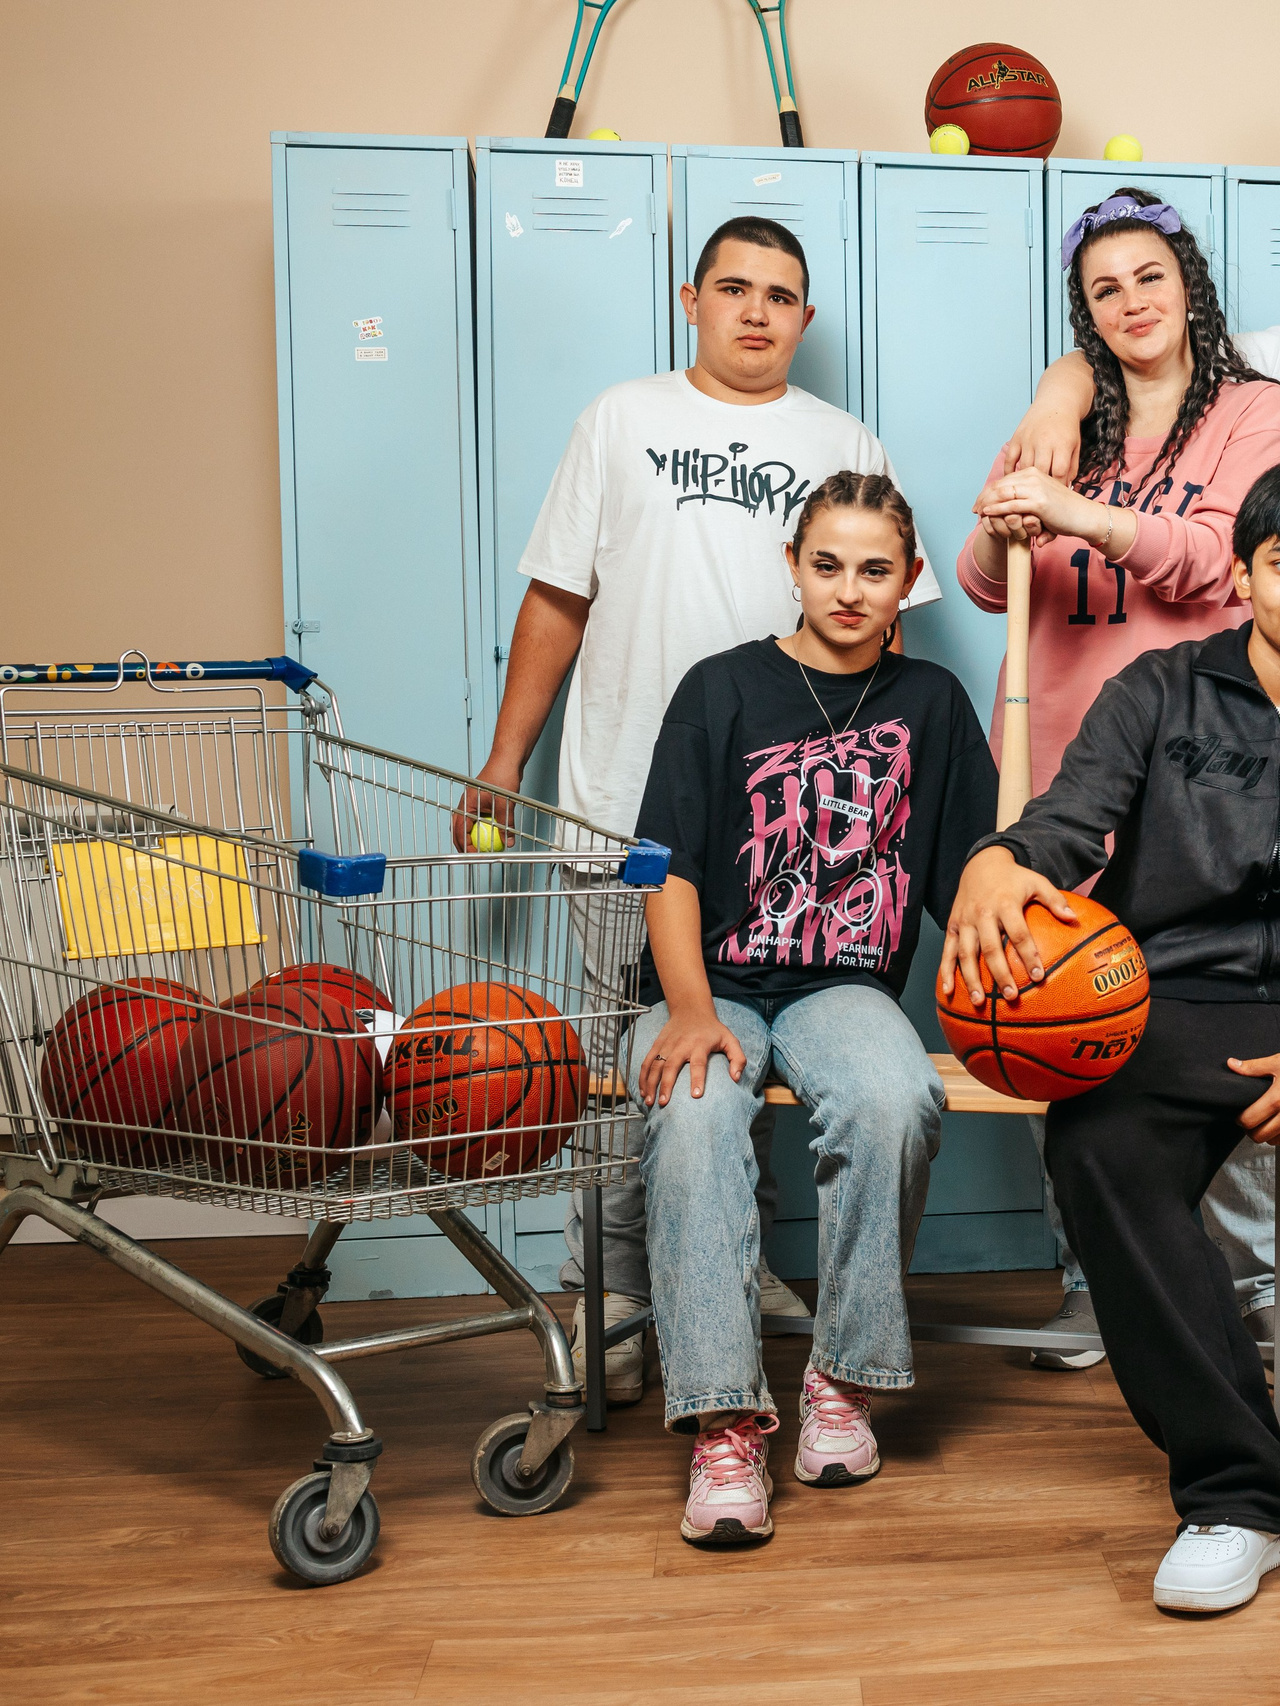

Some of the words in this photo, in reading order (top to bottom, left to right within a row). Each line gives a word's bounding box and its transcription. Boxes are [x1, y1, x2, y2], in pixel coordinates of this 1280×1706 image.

[966, 72, 997, 92] ALL
[1004, 69, 1048, 88] STAR
[1068, 549, 1127, 625] 11
[741, 717, 911, 794] ZERO
[822, 798, 848, 812] LITTLE
[848, 805, 870, 818] BEAR
[748, 934, 802, 949] UNHAPPY
[836, 941, 884, 956] YEARNING
[746, 947, 769, 959] DAY
